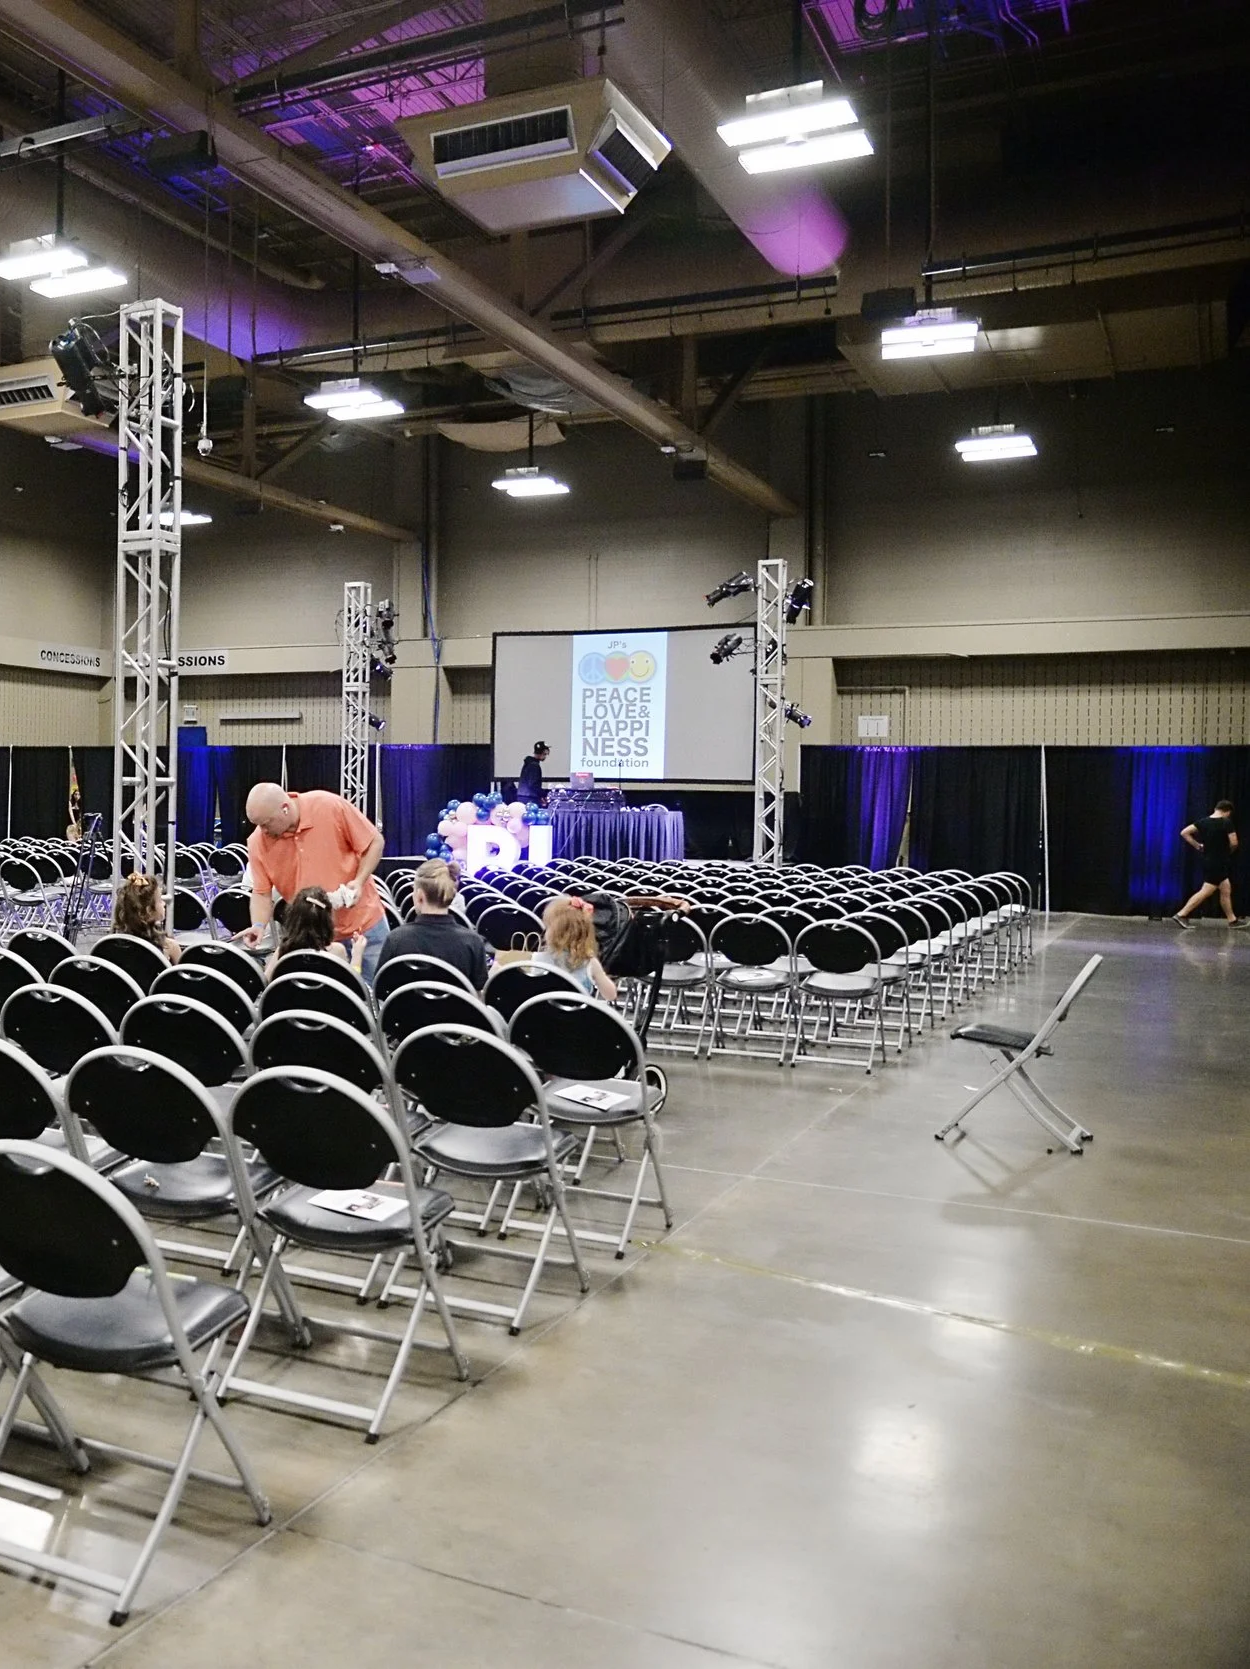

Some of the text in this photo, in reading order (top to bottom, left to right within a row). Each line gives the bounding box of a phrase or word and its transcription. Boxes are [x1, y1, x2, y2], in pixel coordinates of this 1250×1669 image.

[607, 640, 627, 649] JP's
[40, 649, 100, 667] CONCESSIONS
[582, 687, 651, 703] PEACE
[581, 720, 650, 737] HAPPI
[581, 737, 649, 757] NESS
